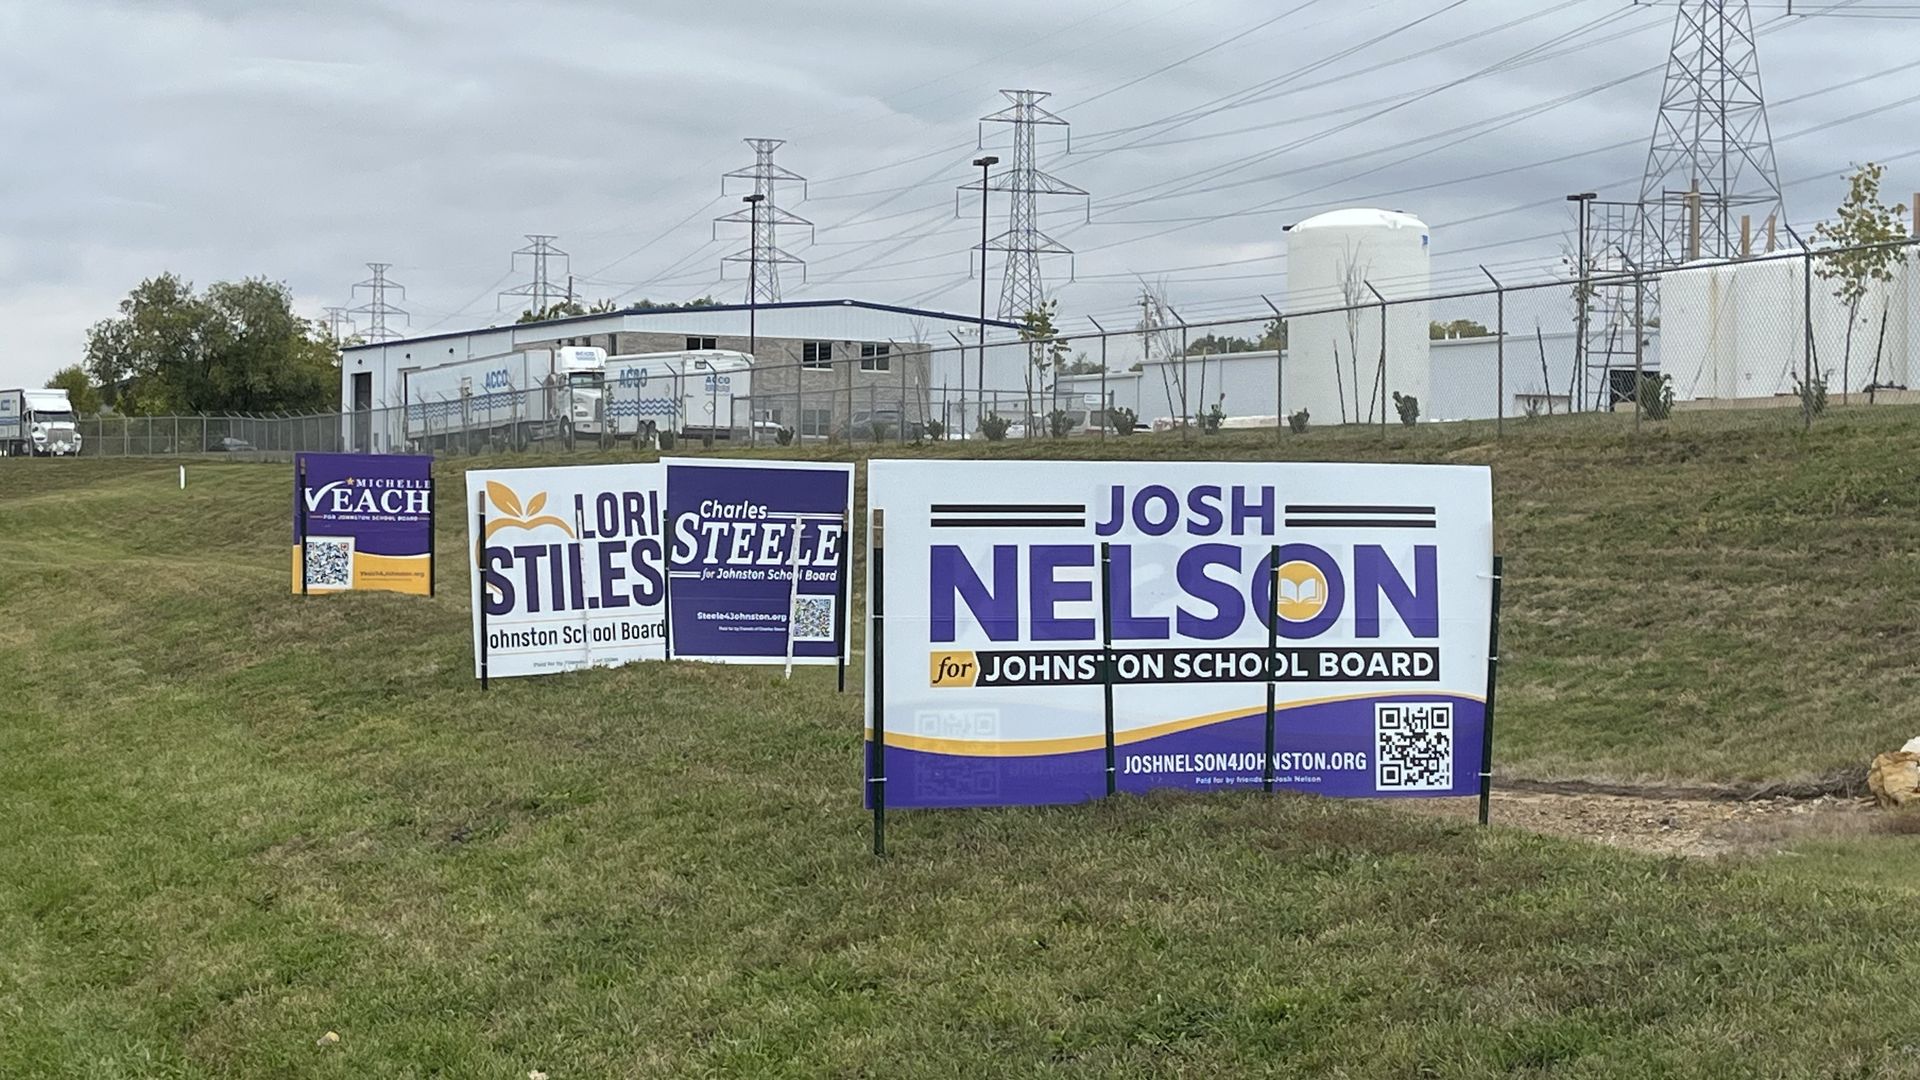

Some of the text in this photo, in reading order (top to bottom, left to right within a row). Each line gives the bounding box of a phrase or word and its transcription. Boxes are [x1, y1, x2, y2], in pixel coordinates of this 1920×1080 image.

[486, 369, 508, 388] ACCO
[356, 479, 431, 488] MICHELLE
[574, 490, 660, 539] LORI
[700, 500, 768, 519] Charles
[1095, 485, 1275, 536] JOSH
[671, 511, 843, 567] STEELE
[486, 538, 664, 616] STILES
[701, 567, 838, 581] for Johnston Schol Board
[930, 543, 1439, 643] NELSON
[697, 611, 788, 622] Steele4Johnston.org
[487, 626, 558, 650] ohnston
[621, 619, 666, 640] Board
[932, 656, 973, 684] for
[1319, 652, 1434, 678] BOARD
[1294, 775, 1322, 783] Nelson
